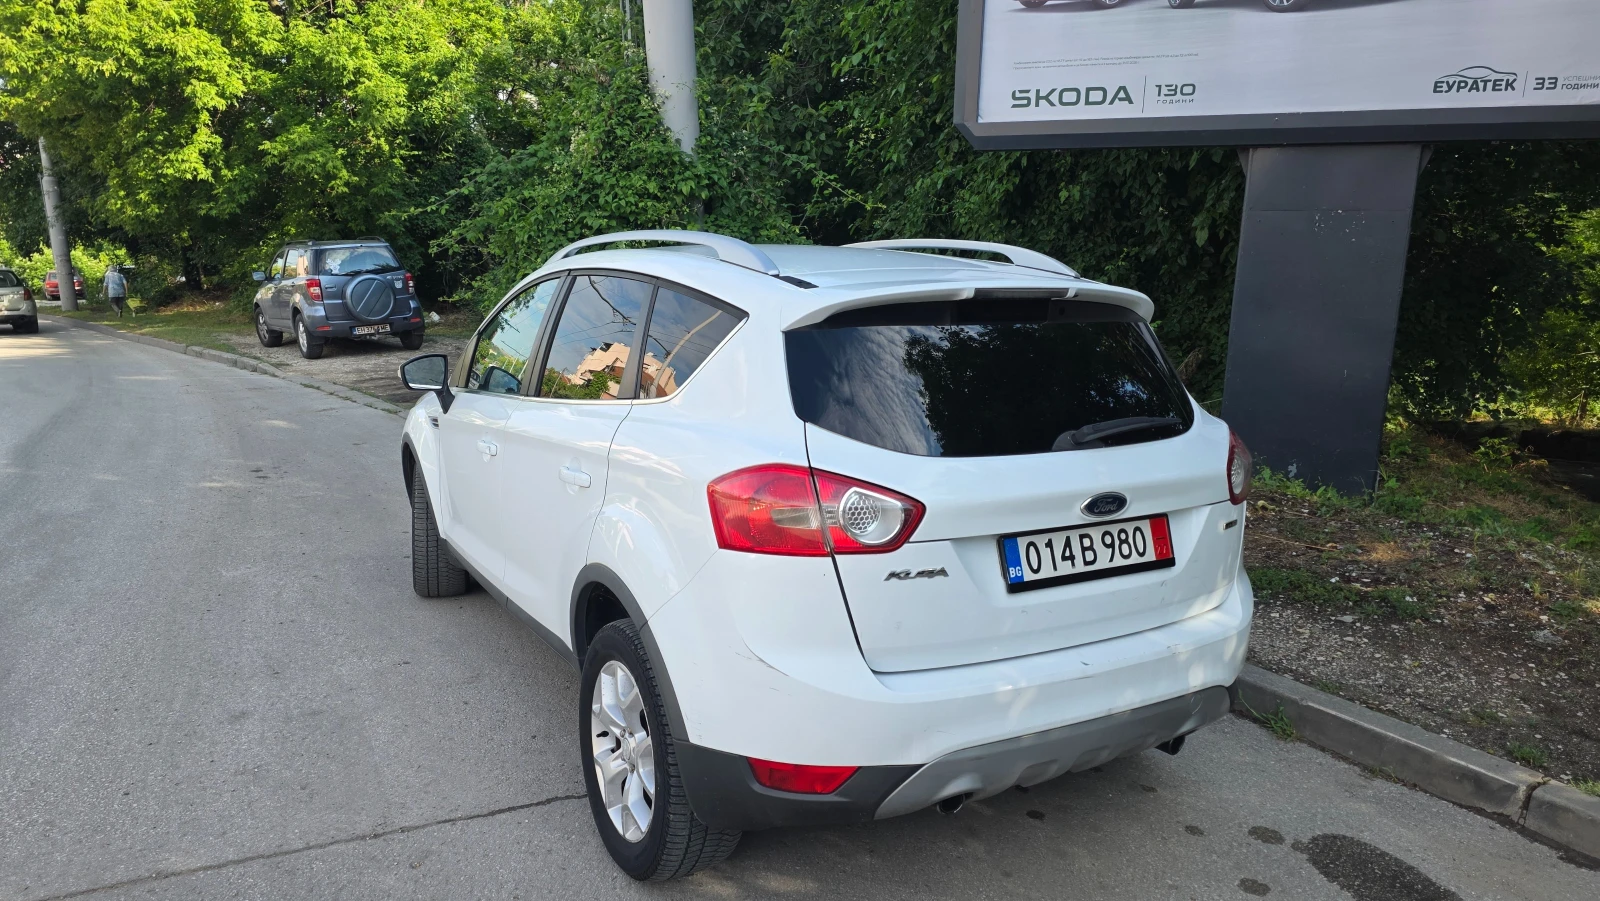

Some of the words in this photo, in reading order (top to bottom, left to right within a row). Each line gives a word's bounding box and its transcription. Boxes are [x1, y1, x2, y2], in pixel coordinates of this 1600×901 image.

[1155, 83, 1196, 97] 130
[1432, 78, 1517, 93] ЕУРАТЕК
[1533, 77, 1558, 90] 33
[1094, 498, 1118, 512] Ford
[1009, 567, 1022, 578] BG
